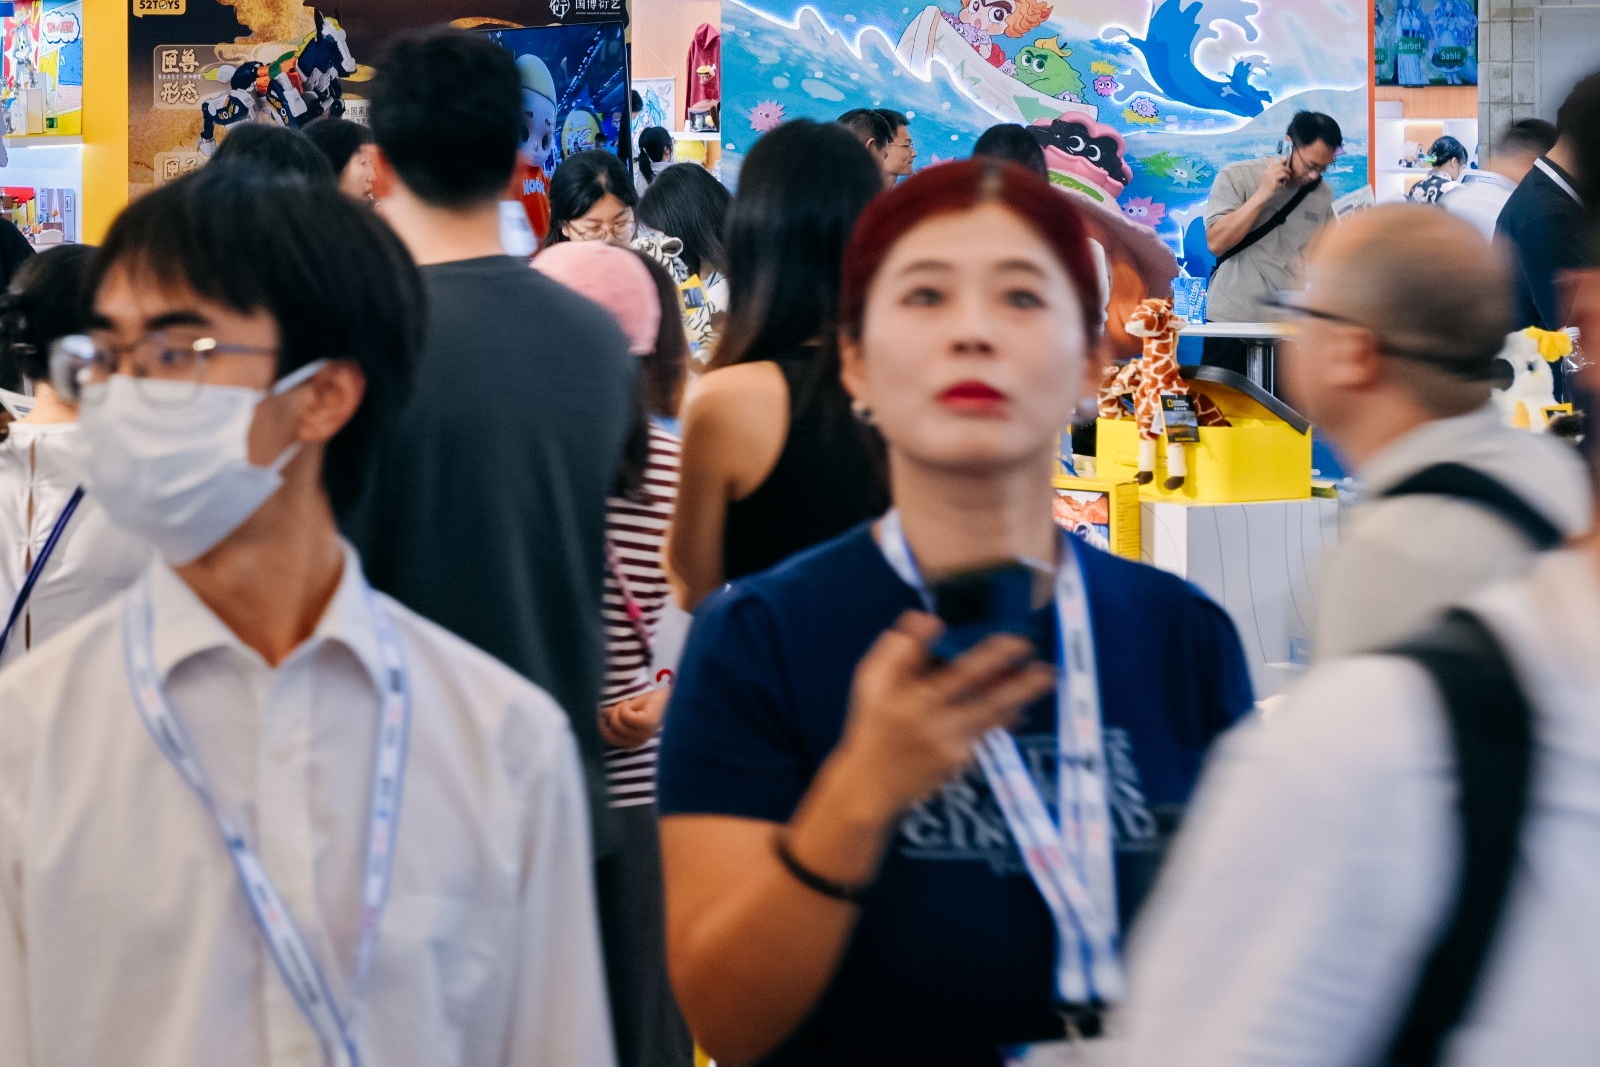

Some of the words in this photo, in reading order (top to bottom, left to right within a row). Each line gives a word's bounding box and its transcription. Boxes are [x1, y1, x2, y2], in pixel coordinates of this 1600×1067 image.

[139, 0, 180, 10] 52TOYS
[1398, 41, 1421, 50] Sorbet
[161, 49, 199, 73] 匣兽
[160, 80, 199, 104] 形态
